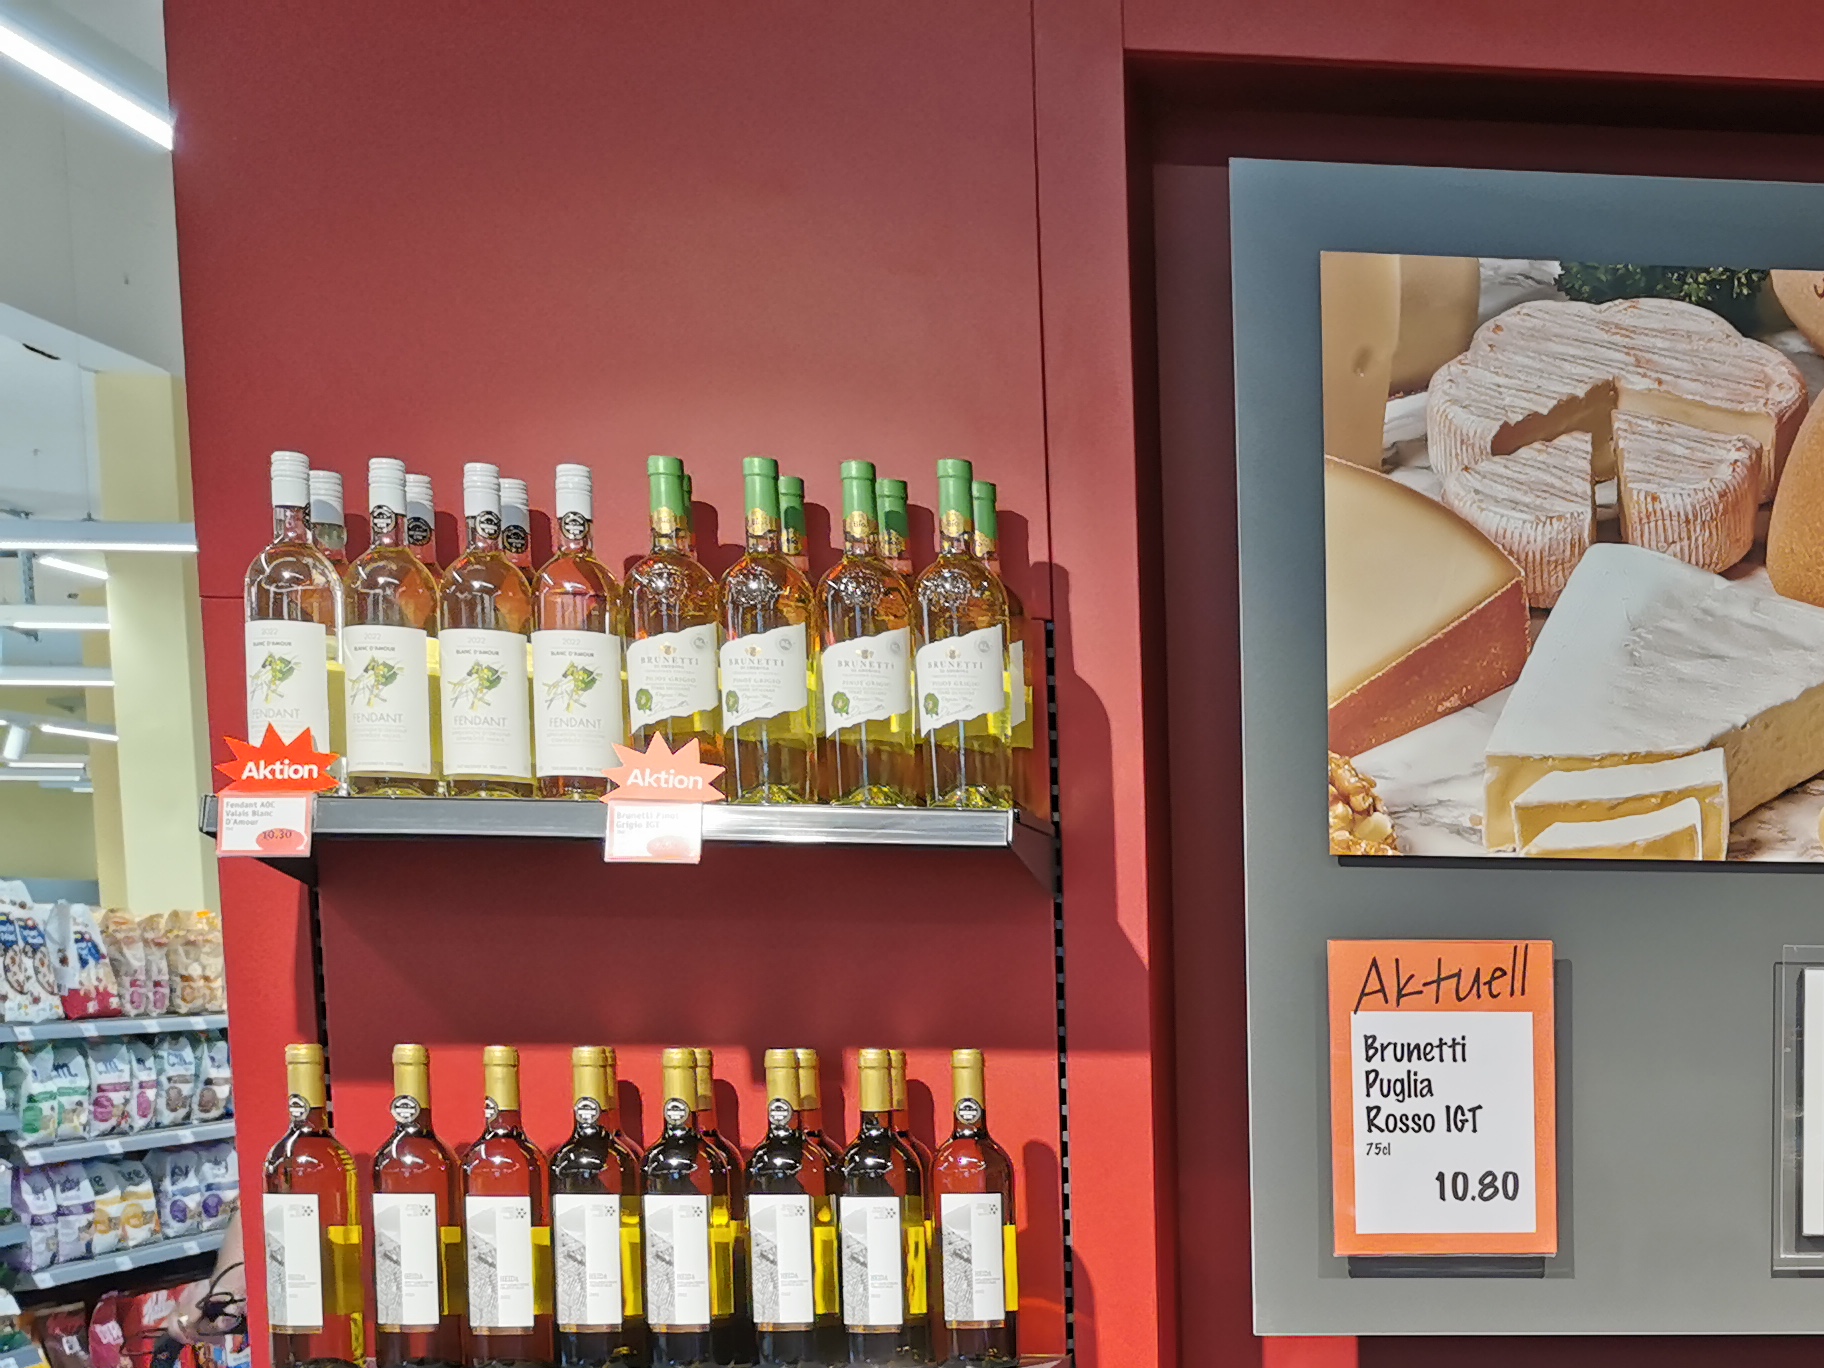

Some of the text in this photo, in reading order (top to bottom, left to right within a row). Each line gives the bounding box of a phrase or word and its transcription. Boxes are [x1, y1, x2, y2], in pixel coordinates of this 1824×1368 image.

[641, 656, 699, 667] BRUNETTI
[729, 658, 785, 668] BRUNETTI
[837, 660, 895, 670] BRUNETTI
[928, 660, 983, 670] BRUNETTI
[251, 708, 300, 721] FENDANT
[352, 712, 403, 725] FENDANT
[453, 716, 507, 730] FENDANT
[549, 717, 601, 731] FENDANT
[240, 758, 319, 781] Aktion
[626, 766, 704, 790] Aktion
[226, 801, 257, 811] Fendant
[226, 810, 273, 819] Valais Blanc
[1354, 943, 1528, 1015] Aktuell
[1363, 1034, 1467, 1062] Brunetti
[1365, 1069, 1433, 1102] Puglia
[1366, 1104, 1483, 1133] Rosso IGT
[1366, 1142, 1391, 1156] 75cl
[1435, 1170, 1519, 1201] 10.80
